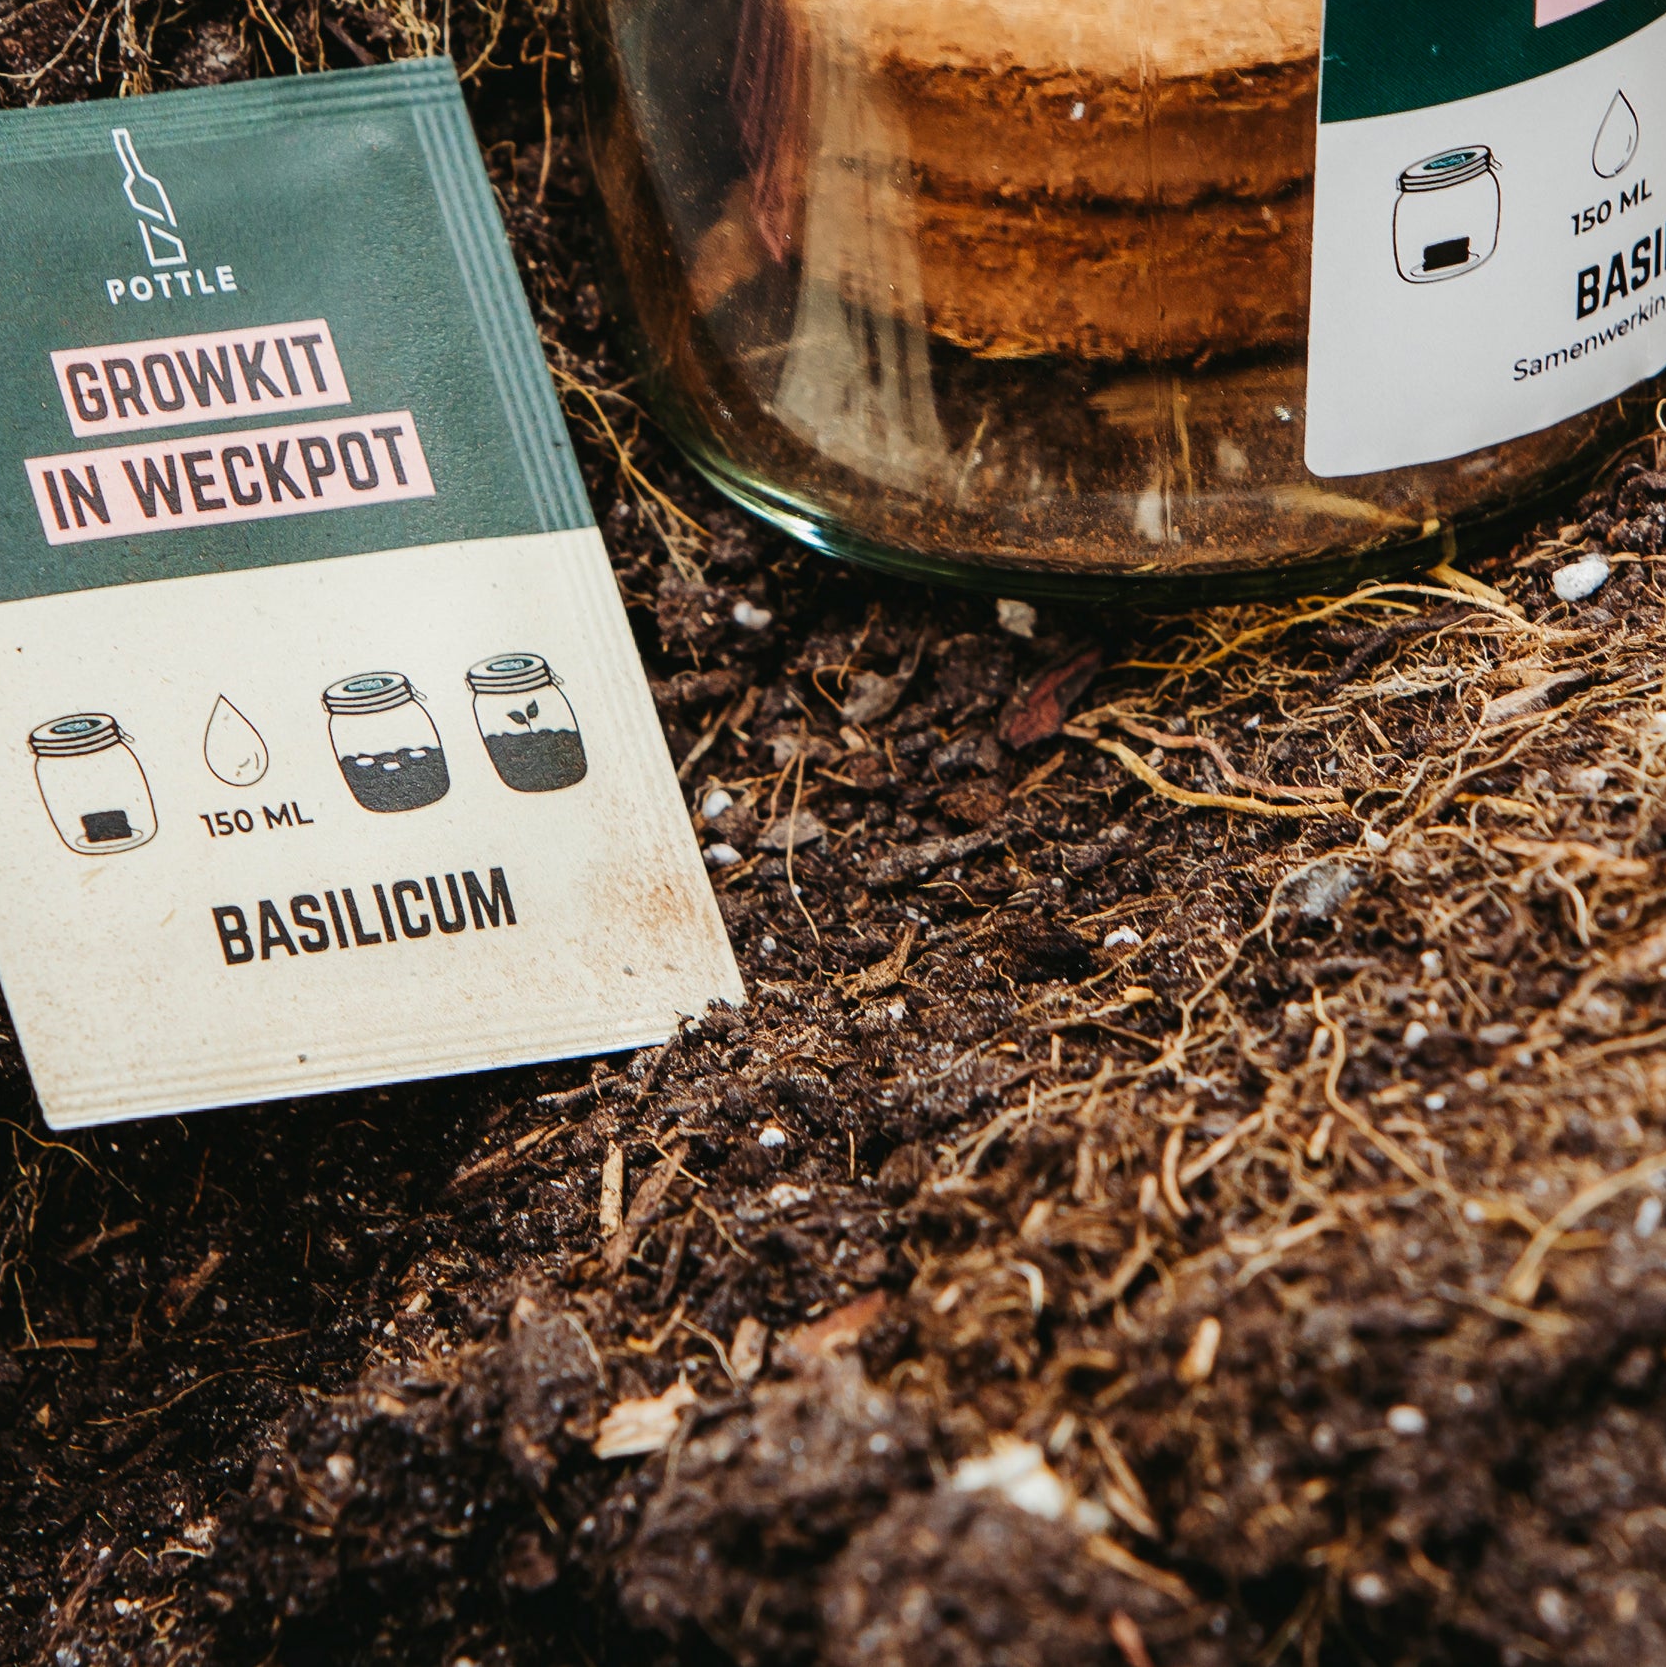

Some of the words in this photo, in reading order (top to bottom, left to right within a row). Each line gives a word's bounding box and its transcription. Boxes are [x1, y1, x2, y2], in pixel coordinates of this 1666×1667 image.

[1571, 200, 1612, 236] 150
[1619, 179, 1652, 215] ML
[106, 265, 237, 305] POTTLE
[65, 334, 330, 422] GROWKIT
[42, 465, 111, 530] IN
[124, 426, 410, 518] WECKPOT
[199, 808, 254, 838] 150
[265, 801, 315, 830] ML
[211, 867, 517, 966] BASILICUM
